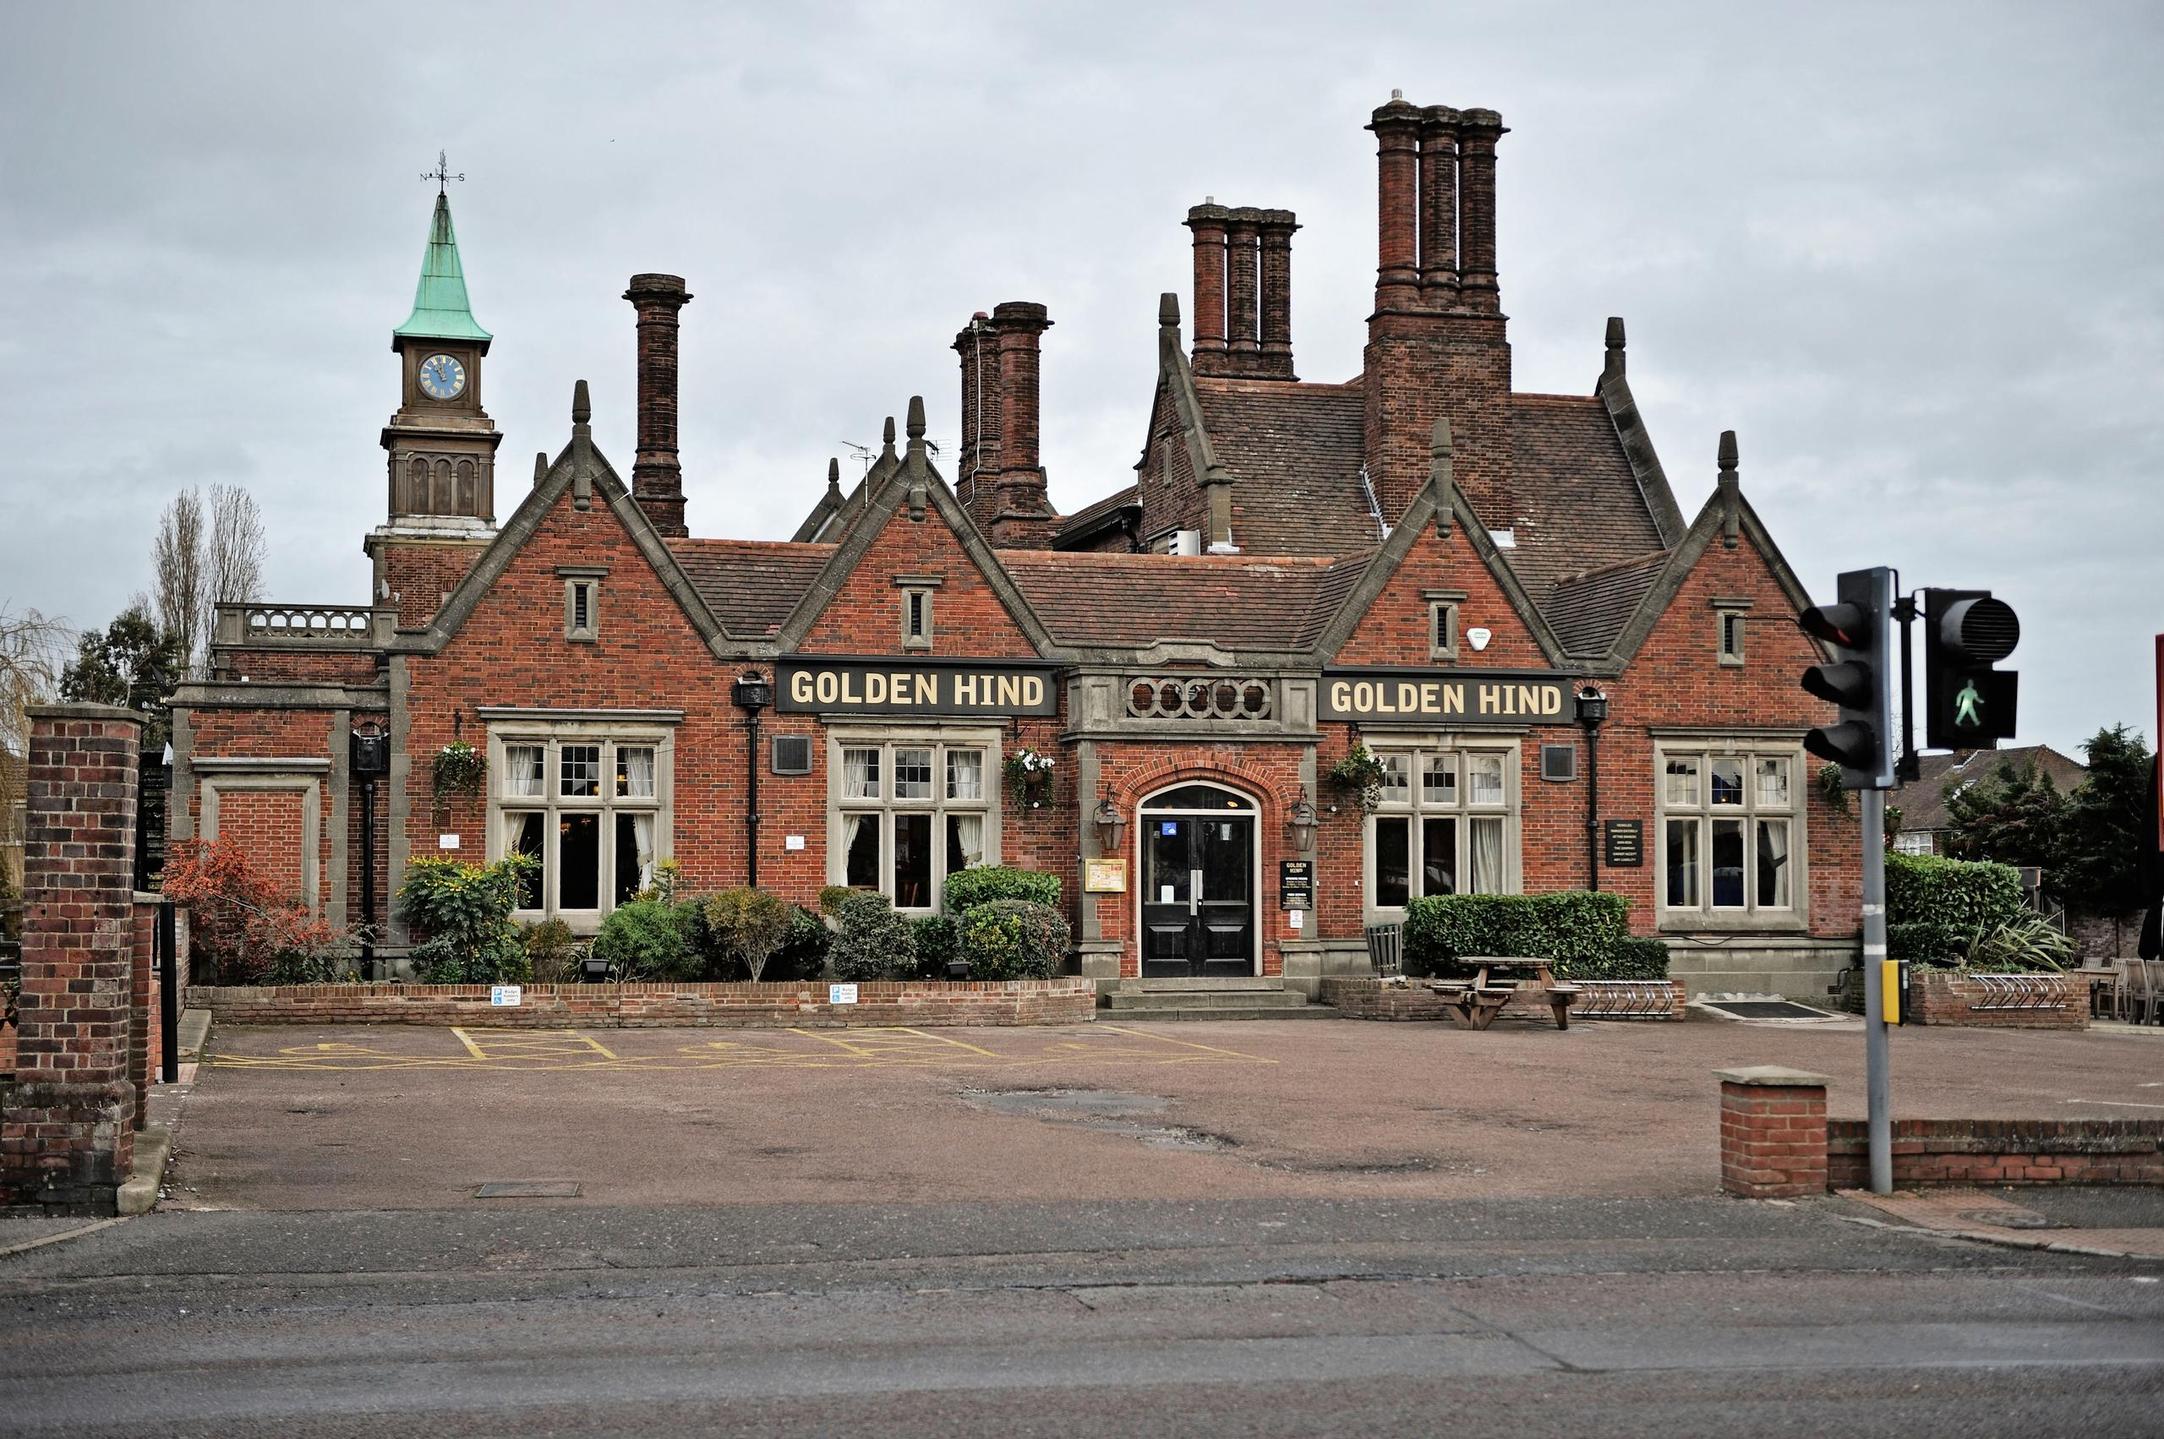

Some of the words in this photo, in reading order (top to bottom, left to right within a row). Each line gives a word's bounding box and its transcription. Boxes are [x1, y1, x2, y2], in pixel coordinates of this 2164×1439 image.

[791, 671, 938, 705] GOLDEN
[954, 674, 1044, 706] HIND
[1331, 681, 1464, 714] GOLDEN
[1479, 684, 1562, 715] HIND
